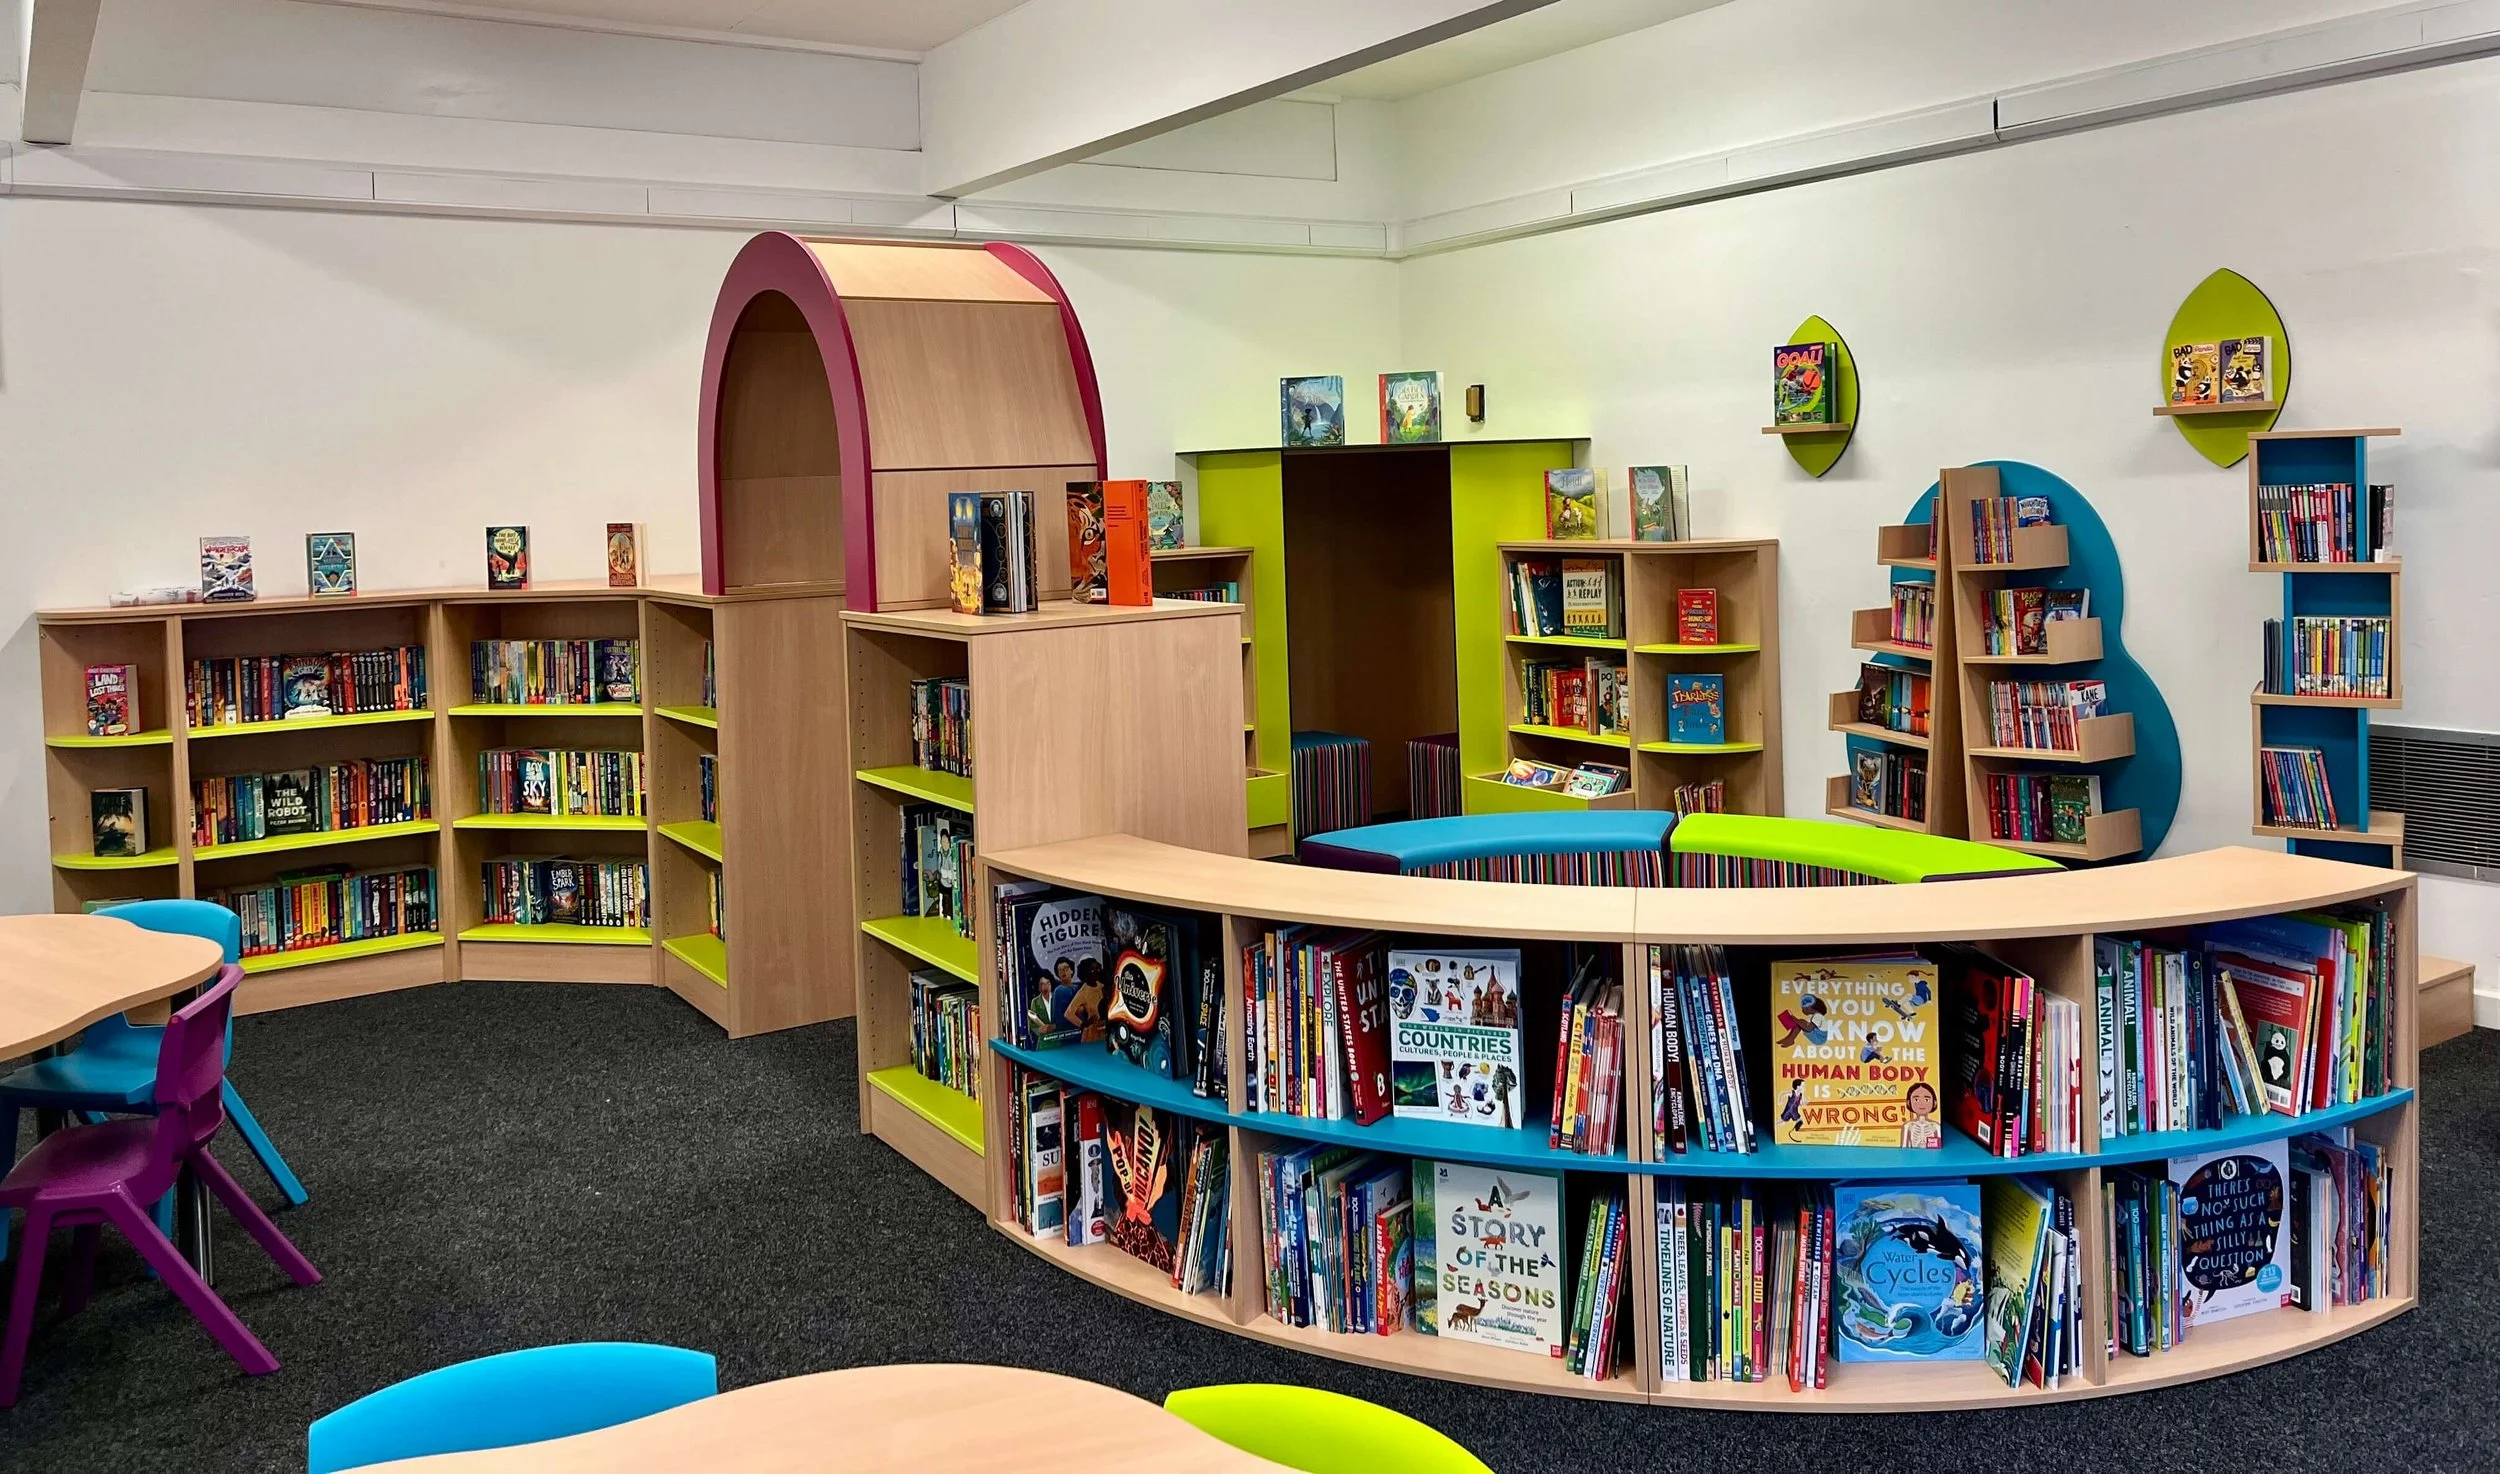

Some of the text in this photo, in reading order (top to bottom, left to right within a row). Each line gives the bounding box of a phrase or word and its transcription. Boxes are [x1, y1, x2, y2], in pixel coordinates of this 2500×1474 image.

[2174, 345, 2193, 359] BAD
[2225, 342, 2242, 355] BAD
[1578, 588, 1603, 600] REPLAY
[94, 674, 118, 686] LAND
[297, 666, 316, 675] GREY
[90, 686, 106, 697] LOST
[1672, 688, 1720, 703] FEARLESS
[2081, 689, 2098, 702] KANE
[526, 761, 543, 772] BOY
[274, 788, 298, 797] THE
[523, 780, 546, 797] SKY
[267, 806, 308, 817] ROBOT
[271, 797, 304, 807] WILD
[551, 868, 573, 880] EMBER
[552, 878, 575, 891] SPARK
[1040, 908, 1102, 931] HIDDEN
[1125, 970, 1134, 980] the
[1114, 975, 1158, 1005] Universe
[1781, 981, 1904, 996] EVERYTHING
[2123, 971, 2135, 1025] ANIMAL!
[1200, 1002, 1209, 1026] SPACE
[1286, 998, 1292, 1007] OF
[1711, 981, 1723, 1027] EYEWITNESS
[1826, 1000, 1876, 1016] YOU
[1334, 961, 1357, 1071] THE UNITED STATES BOOK
[1560, 1011, 1570, 1042] SCOTLAND
[1662, 987, 1679, 1062] HUMAN BODY!
[2100, 995, 2113, 1056] ANIMAL
[1246, 998, 1255, 1061] Amazing Earth
[1572, 1021, 1583, 1054] CITIES
[1698, 1018, 1709, 1052] HOSPITAL
[1704, 1014, 1717, 1043] GENES
[1827, 1020, 1926, 1042] KNOW
[1287, 1037, 1293, 1045] IN
[1398, 1030, 1512, 1055] COUNTRIES
[1711, 1044, 1720, 1060] and
[1399, 1046, 1442, 1057] CULTURES,
[1443, 1049, 1473, 1059] PEOPLE
[1481, 1053, 1512, 1063] PLACES
[1722, 1041, 1735, 1089] HUMAN BODY
[1792, 1046, 1926, 1062] ABOUT THE
[2171, 1058, 2177, 1067] OF
[1713, 1061, 1723, 1081] DNA
[1782, 1063, 1929, 1082] HUMAN BODY
[1813, 1085, 1831, 1098] IS
[1670, 1087, 1679, 1130] ENCYCLOPEDIA
[1676, 1091, 1685, 1126] KNOWLEDGE
[1802, 1105, 1907, 1125] WRONG!
[1112, 1146, 1134, 1195] POP-UP
[1134, 1117, 1155, 1206] VOLCANO!
[1488, 1185, 1504, 1208] A
[2208, 1178, 2251, 1199] THERE'S
[2132, 1207, 2140, 1223] 100
[2201, 1192, 2266, 1217] NO SUCH
[1451, 1213, 1546, 1248] STORY
[1604, 1212, 1616, 1256] EYEWITNESS
[2193, 1213, 2266, 1239] THING AS A
[1586, 1240, 1594, 1248] THE
[1677, 1230, 1686, 1258] TREES,
[1799, 1234, 1807, 1260] AMAZING
[2215, 1232, 2247, 1251] SILLY
[1377, 1223, 1386, 1285] EARTH HEROES
[1456, 1246, 1539, 1278] OF THE
[1582, 1248, 1592, 1281] WEATHER?
[1812, 1214, 1823, 1300] EYEWITNESS OCEAN
[1882, 1251, 1918, 1263] Water
[2199, 1249, 2264, 1270] QUESTION
[1678, 1259, 1686, 1292] LEAVES,
[1754, 1236, 1763, 1303] 100 FOOD
[1866, 1260, 1952, 1293] Cycles
[1442, 1274, 1556, 1309] SEASONS
[1595, 1269, 1607, 1310] HURRICANE
[1660, 1228, 1675, 1366] TIMELINES OF NATURE
[1501, 1304, 1521, 1313] Discover
[1506, 1312, 1526, 1320] through
[1679, 1293, 1687, 1331] FLOWERS
[1589, 1319, 1599, 1354] TORNADO
[1680, 1339, 1688, 1365] SEEDS
